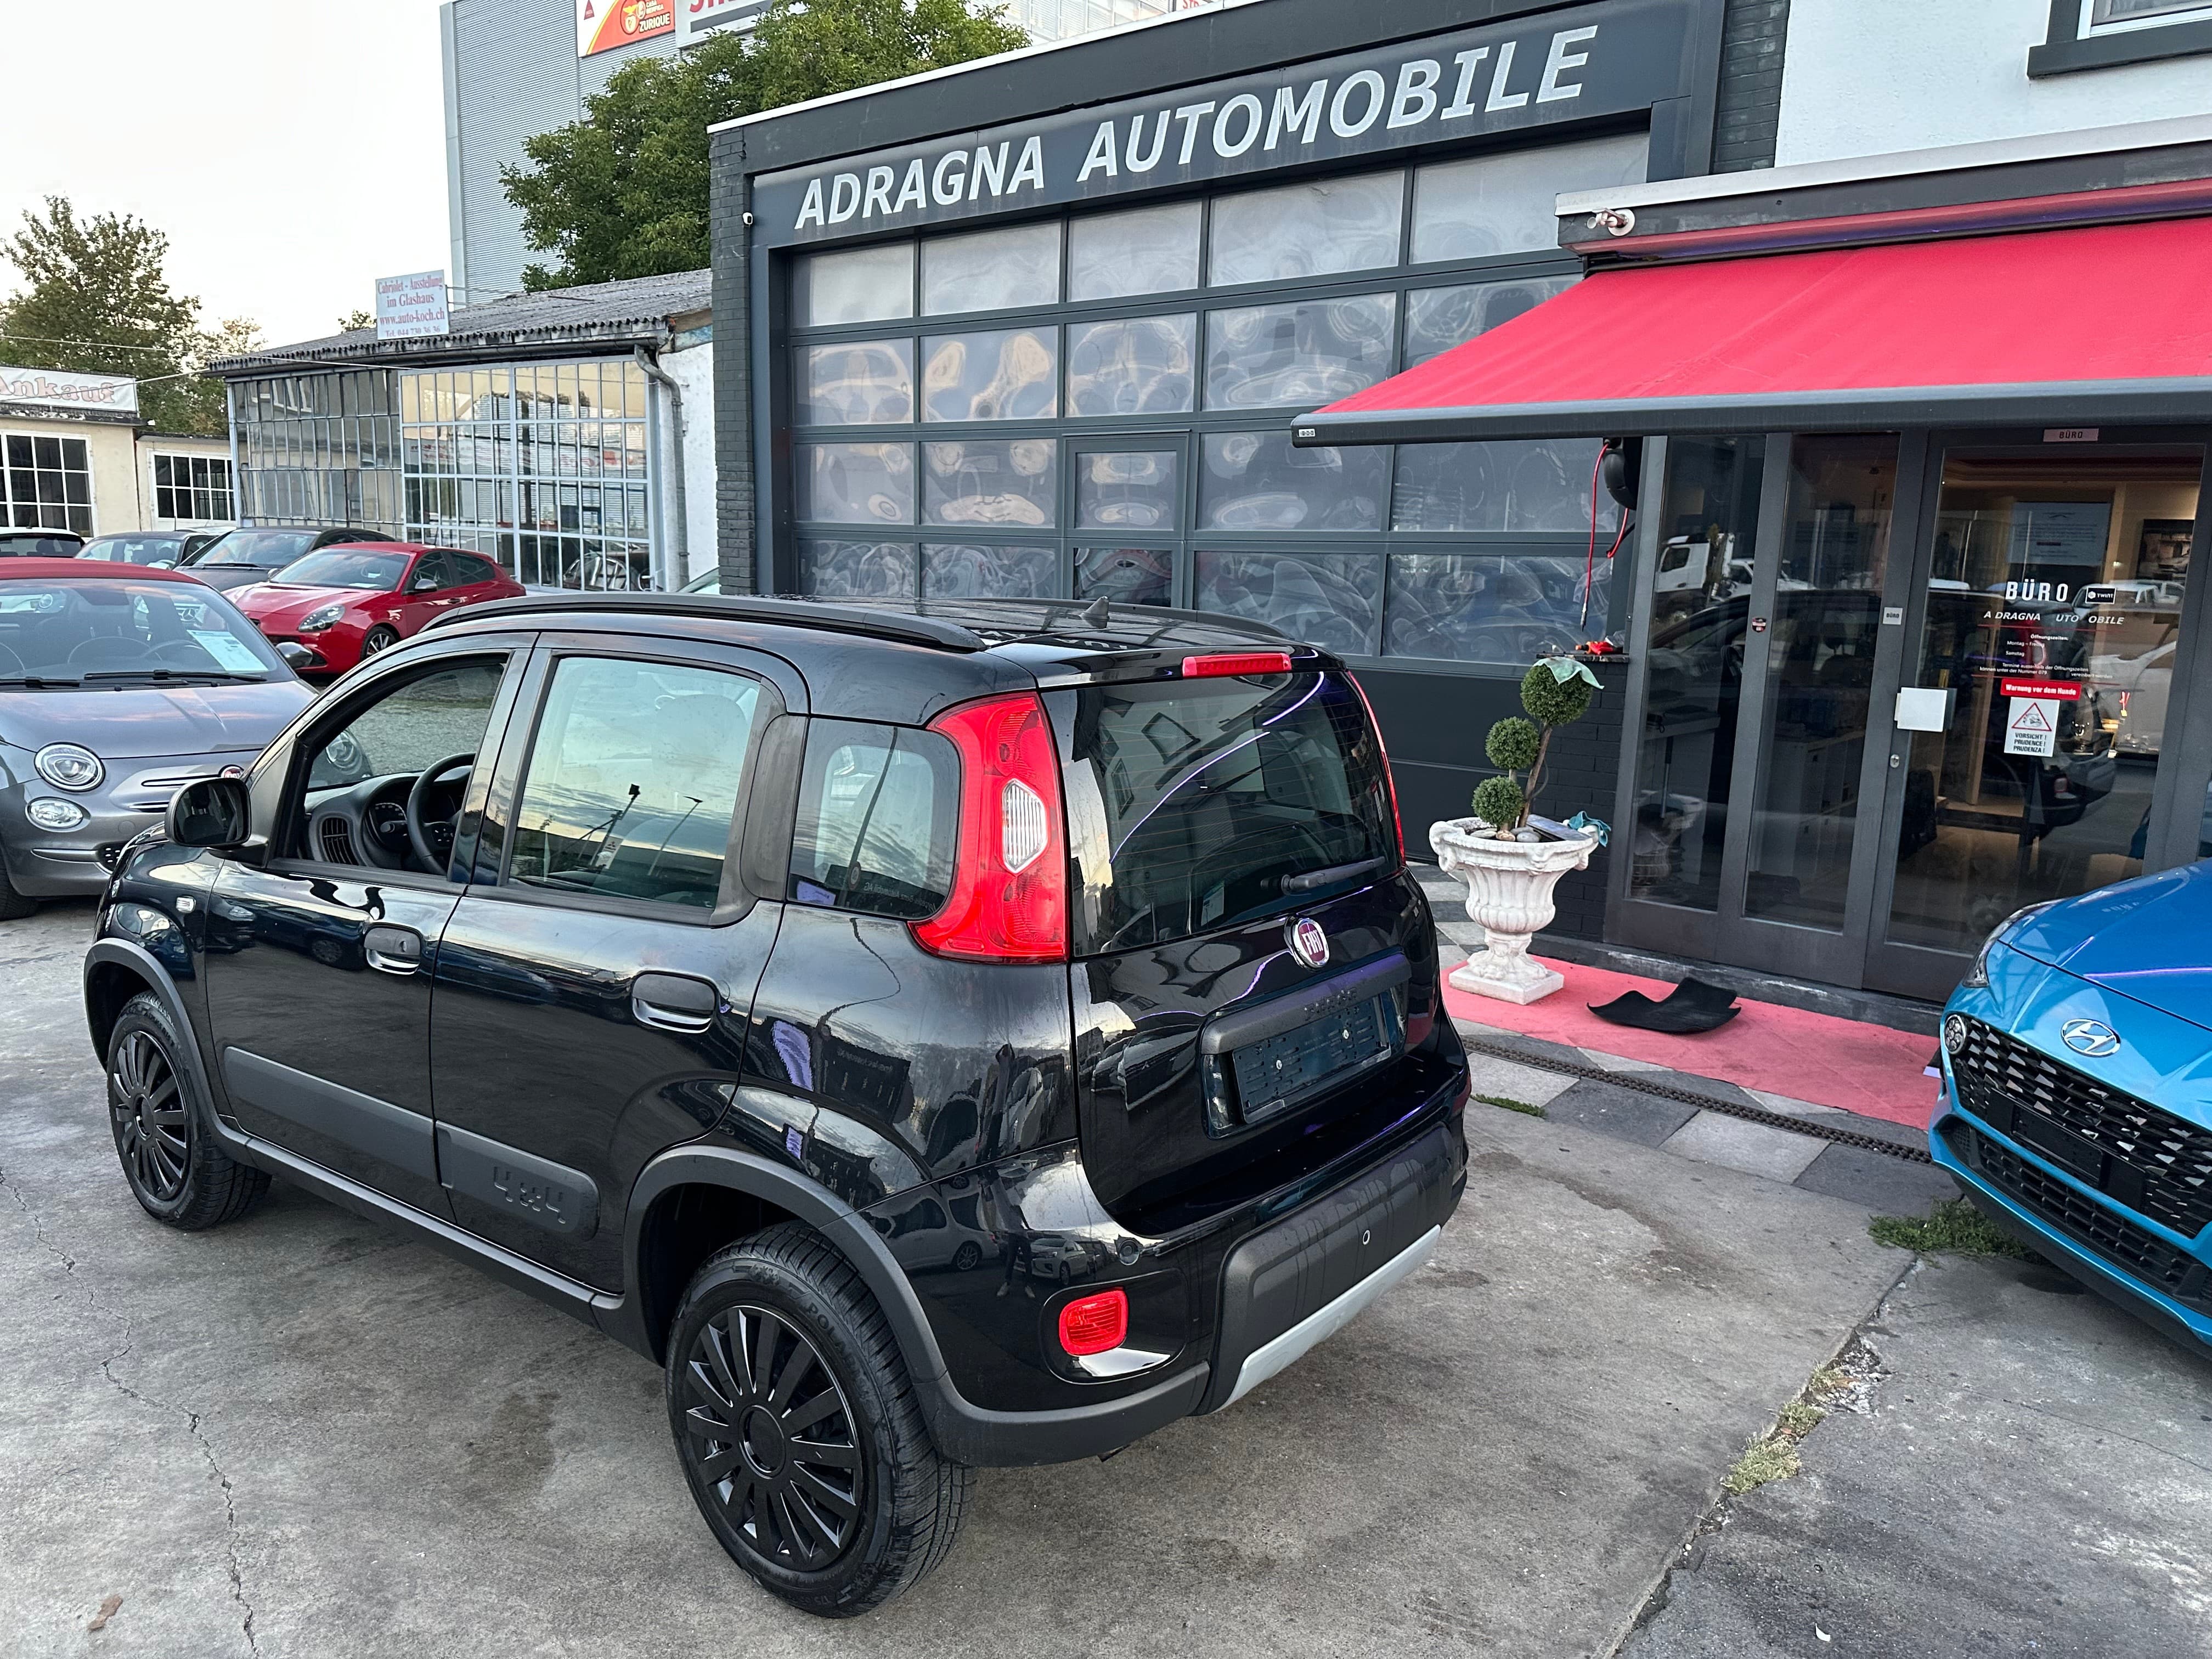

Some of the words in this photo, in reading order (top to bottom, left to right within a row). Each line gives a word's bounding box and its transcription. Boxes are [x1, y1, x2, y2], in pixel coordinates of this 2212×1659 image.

[639, 13, 670, 33] ZURIQUE
[794, 136, 1045, 229] ADRAGNA
[1076, 25, 1598, 183] AUTOMOBILE
[410, 275, 443, 290] Ausstellung
[387, 296, 397, 307] im
[399, 292, 435, 307] Glashaus
[380, 307, 445, 325] www.auto-koch.ch
[2059, 430, 2083, 439] BÜRO
[2005, 579, 2068, 602] BÜRO
[2006, 684, 2032, 693] Warnung
[1301, 929, 1324, 956] FIAT
